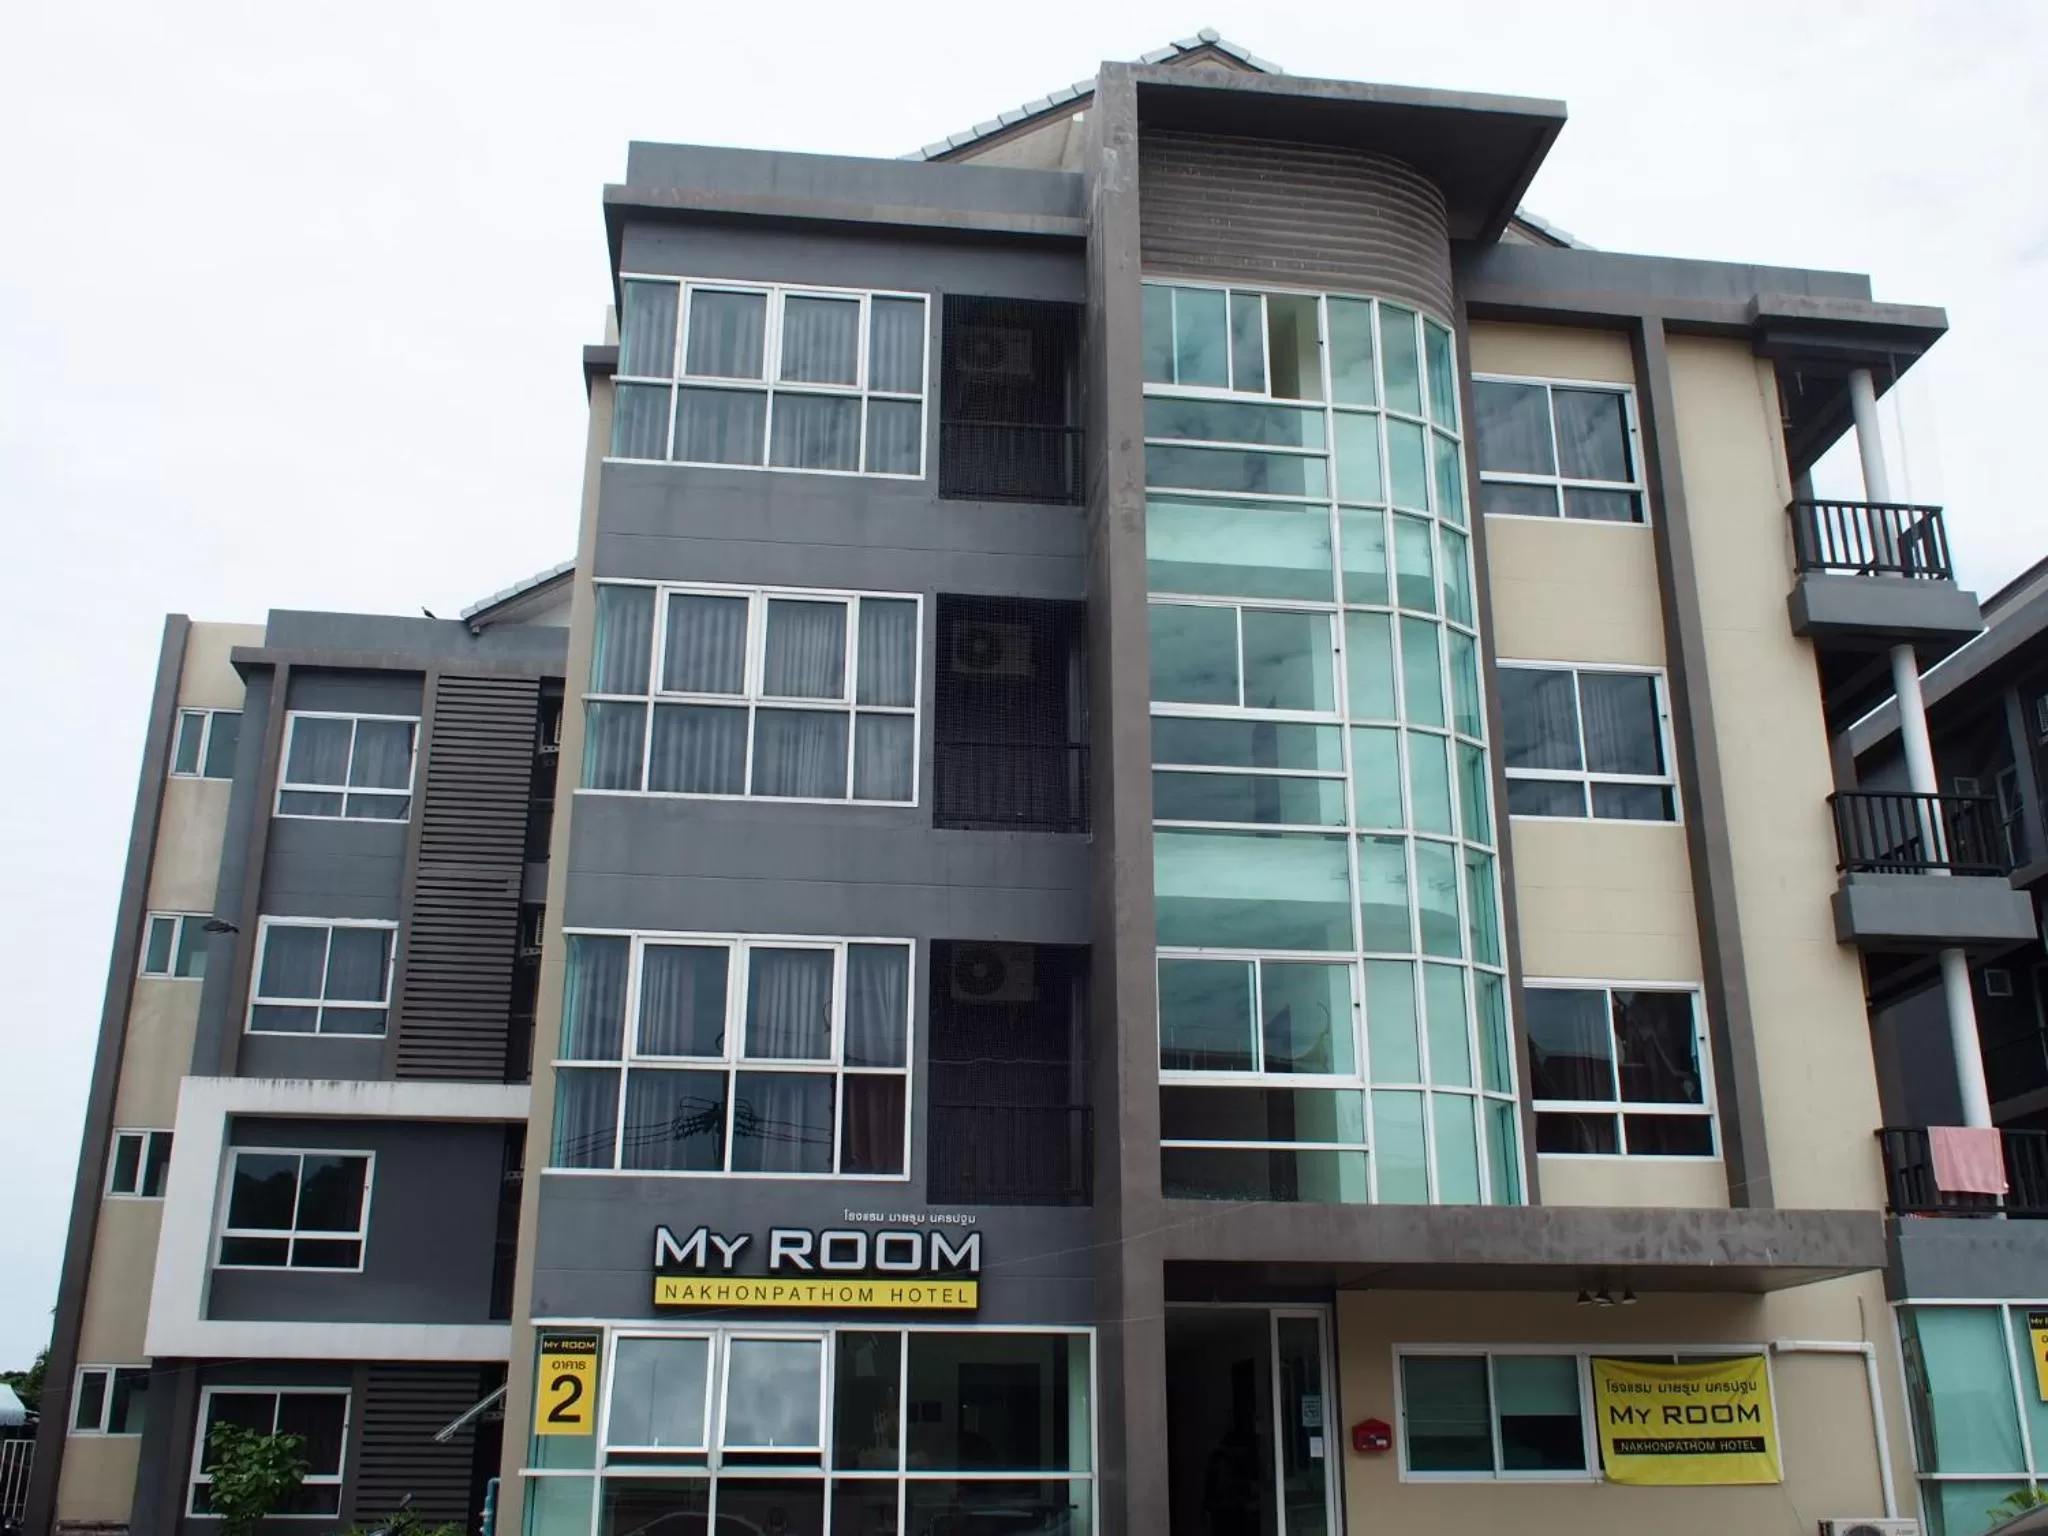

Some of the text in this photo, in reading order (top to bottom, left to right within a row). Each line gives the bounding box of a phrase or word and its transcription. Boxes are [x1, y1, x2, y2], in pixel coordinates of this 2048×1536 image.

[844, 1208, 884, 1221] โรงแรม
[768, 1229, 981, 1273] ROOM
[665, 1283, 969, 1304] NAKHONPATHOM HOTEL
[561, 1341, 596, 1350] ROOM
[552, 1360, 587, 1370] อาคาร
[1606, 1379, 1757, 1396] โรงแรม มายรูม นครปฐม
[547, 1374, 583, 1423] 2
[1661, 1403, 1761, 1425] ROOM
[1620, 1439, 1757, 1452] NAKHONPATHOM HOTEL
